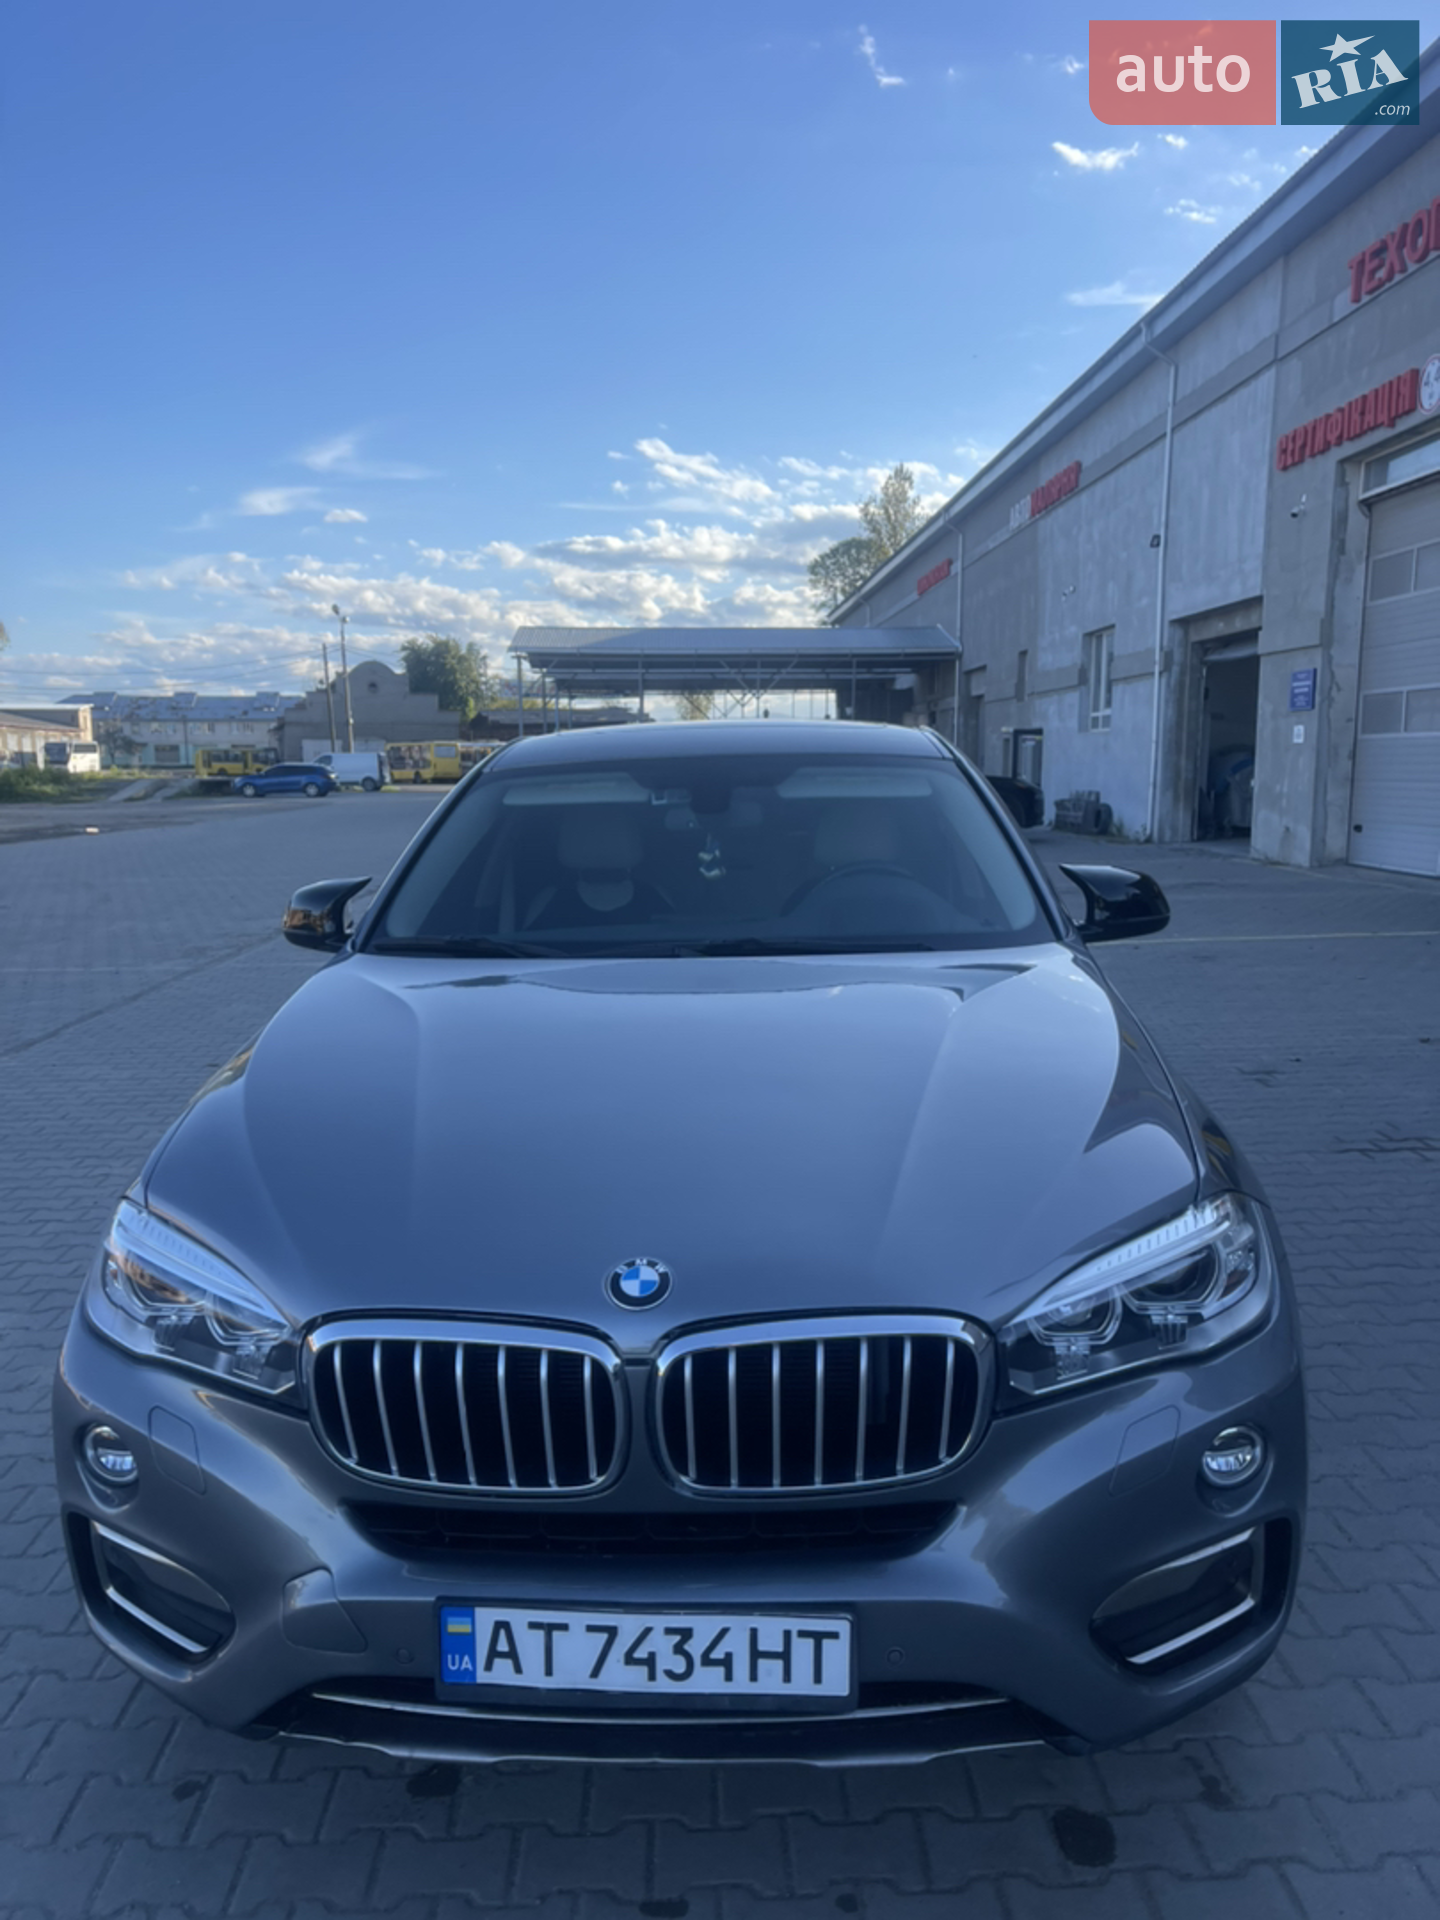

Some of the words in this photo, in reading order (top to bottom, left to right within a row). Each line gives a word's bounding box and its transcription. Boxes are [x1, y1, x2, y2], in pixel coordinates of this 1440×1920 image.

[1276, 367, 1420, 472] СЕРТИФІКАЦІЯ
[447, 1653, 474, 1671] UA
[483, 1619, 570, 1678] AT
[585, 1624, 734, 1683] 7434
